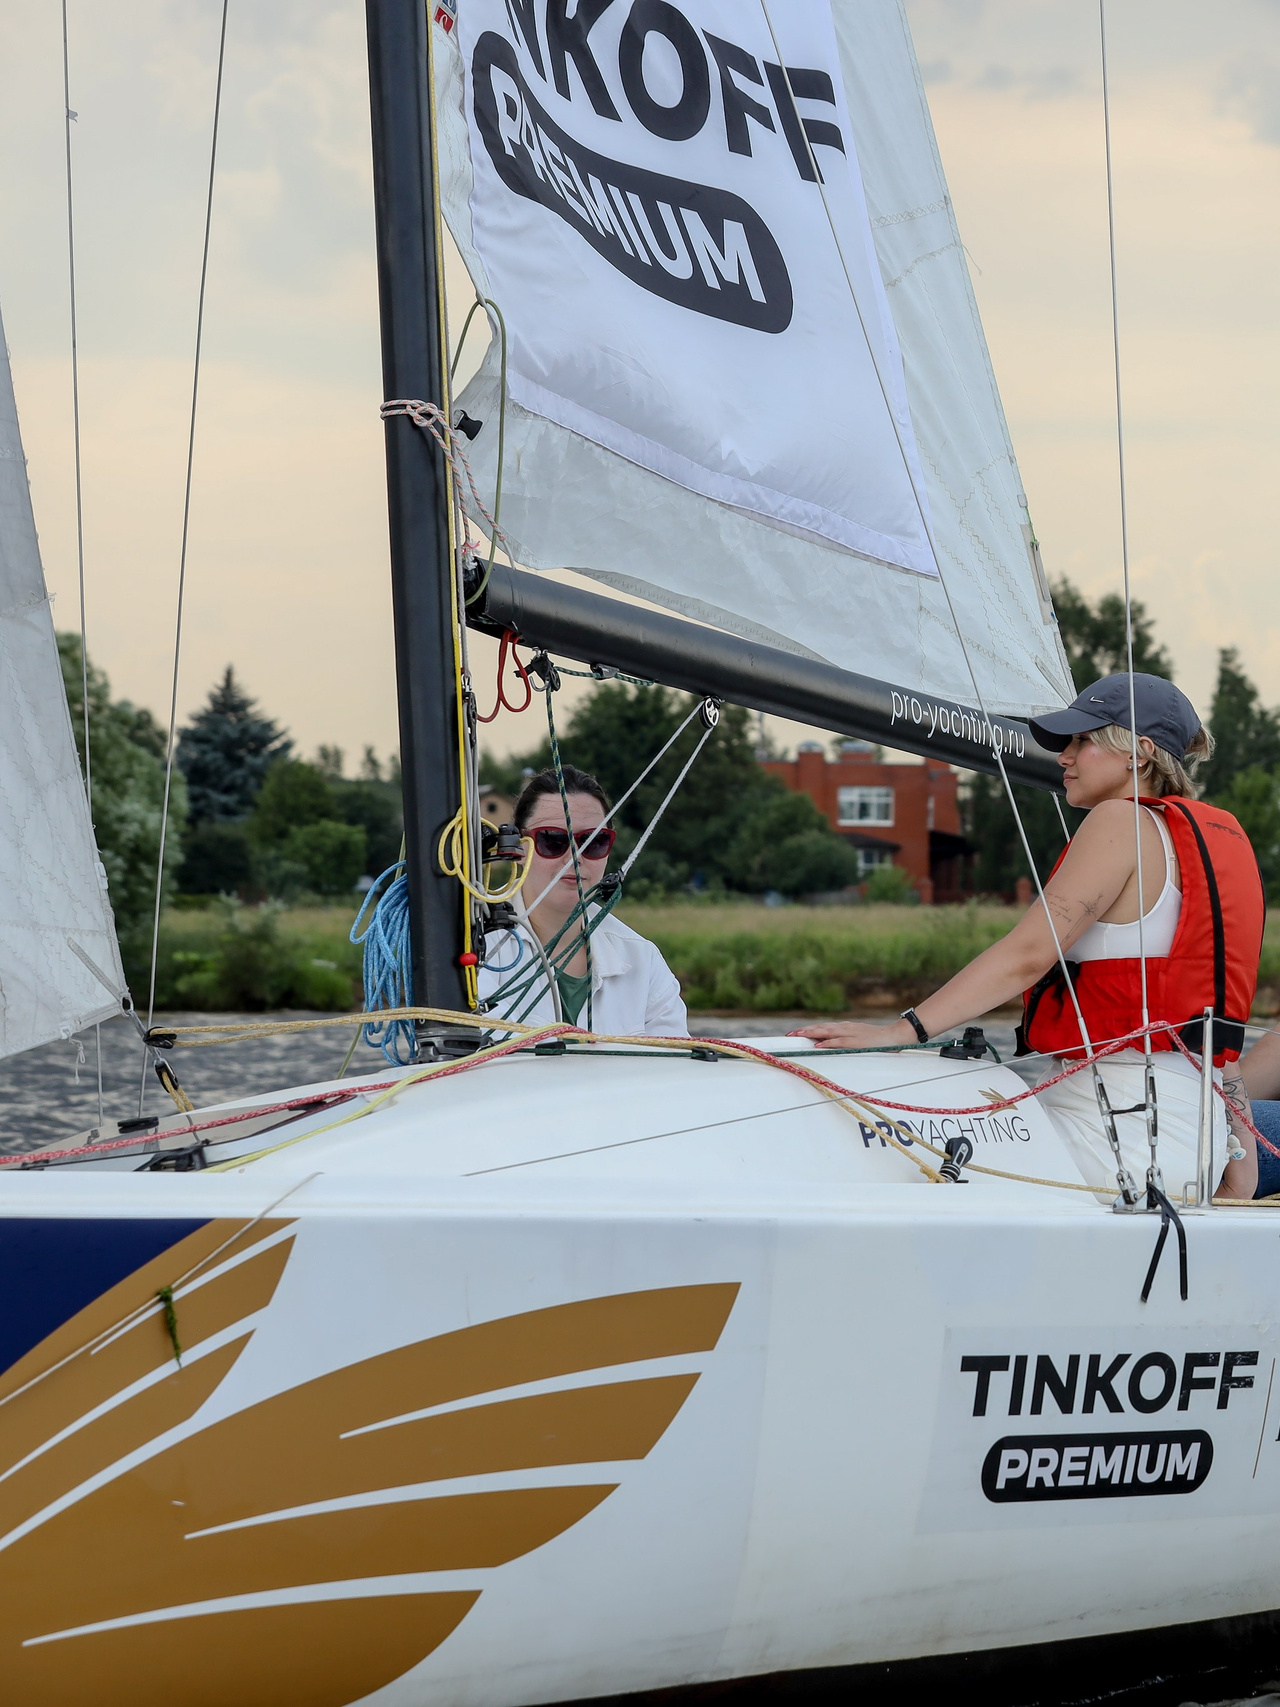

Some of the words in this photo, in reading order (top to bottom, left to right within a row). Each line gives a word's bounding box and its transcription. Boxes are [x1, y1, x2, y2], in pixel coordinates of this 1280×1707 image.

[505, 0, 848, 185] NKOFF
[489, 63, 767, 304] PREMIUM
[890, 690, 1026, 760] pro-yachting.ru
[859, 1116, 1031, 1148] PROYACHTING
[960, 1350, 1260, 1417] TINKOFF
[995, 1442, 1201, 1490] PREMIUM
